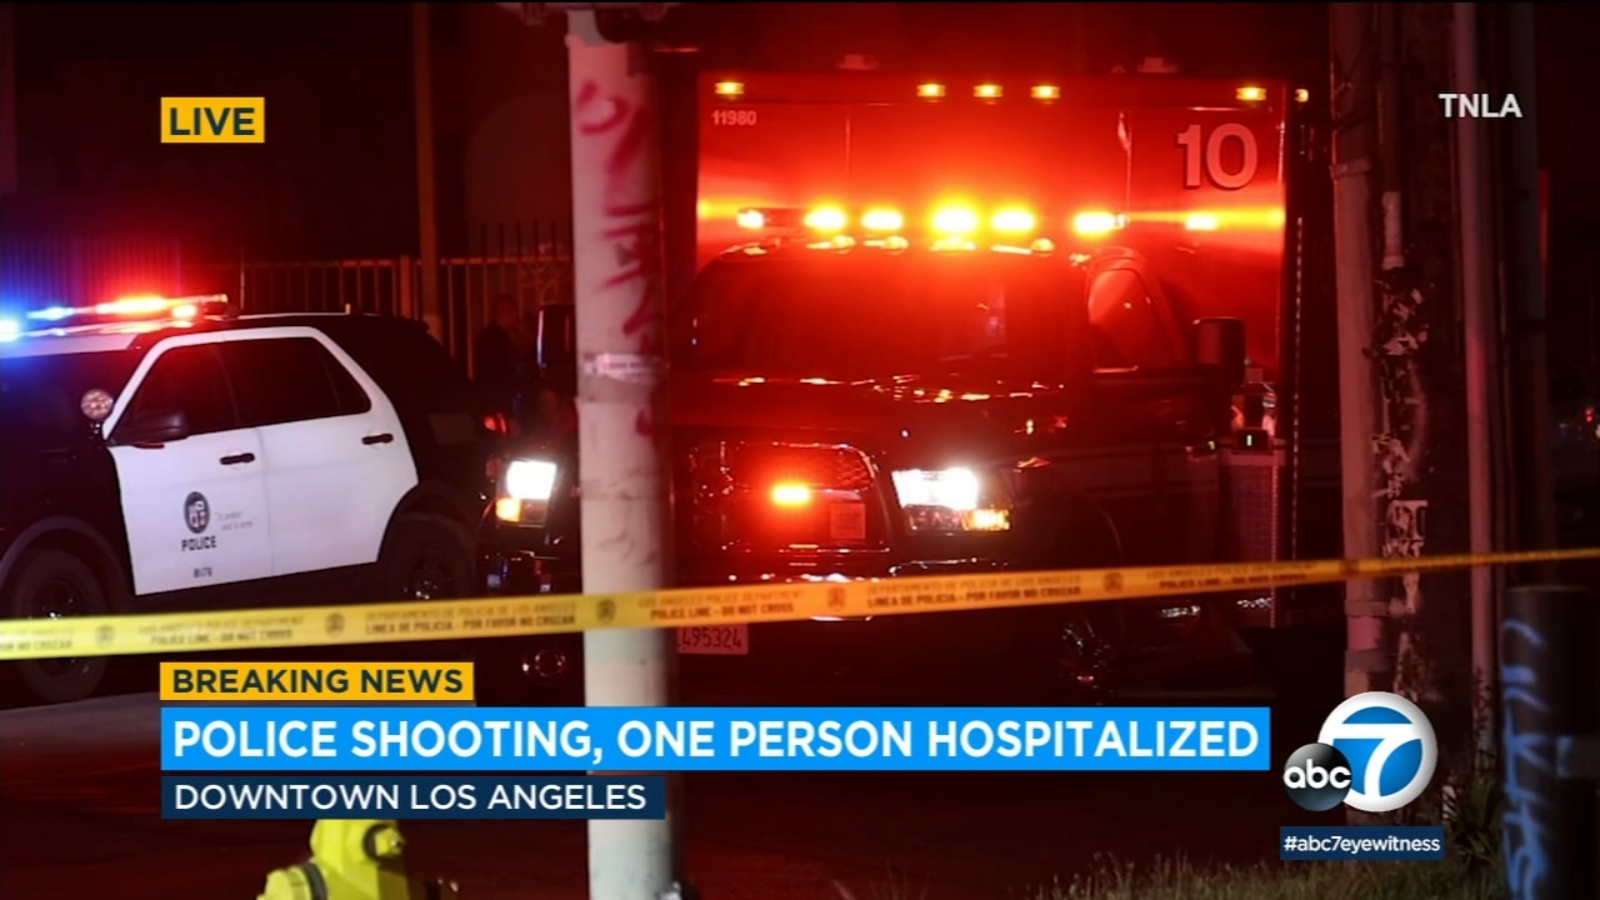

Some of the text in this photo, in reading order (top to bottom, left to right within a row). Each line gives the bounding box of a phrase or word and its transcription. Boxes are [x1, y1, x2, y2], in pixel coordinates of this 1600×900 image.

[711, 109, 757, 126] 11980
[1177, 123, 1258, 188] 10
[181, 535, 217, 552] POLICE
[867, 597, 897, 608] LINEA
[900, 596, 913, 606] DE
[916, 593, 955, 605] POLICIA
[966, 591, 986, 602] POR
[989, 589, 1020, 601] FAVOR
[1024, 588, 1037, 599] NO
[1040, 586, 1081, 598] CRUZAR
[650, 608, 685, 620] POLICE
[688, 607, 711, 618] LINE
[721, 606, 735, 616] DO
[738, 604, 757, 615] NOT
[760, 602, 794, 614] CROSS
[677, 627, 742, 649] 495324
